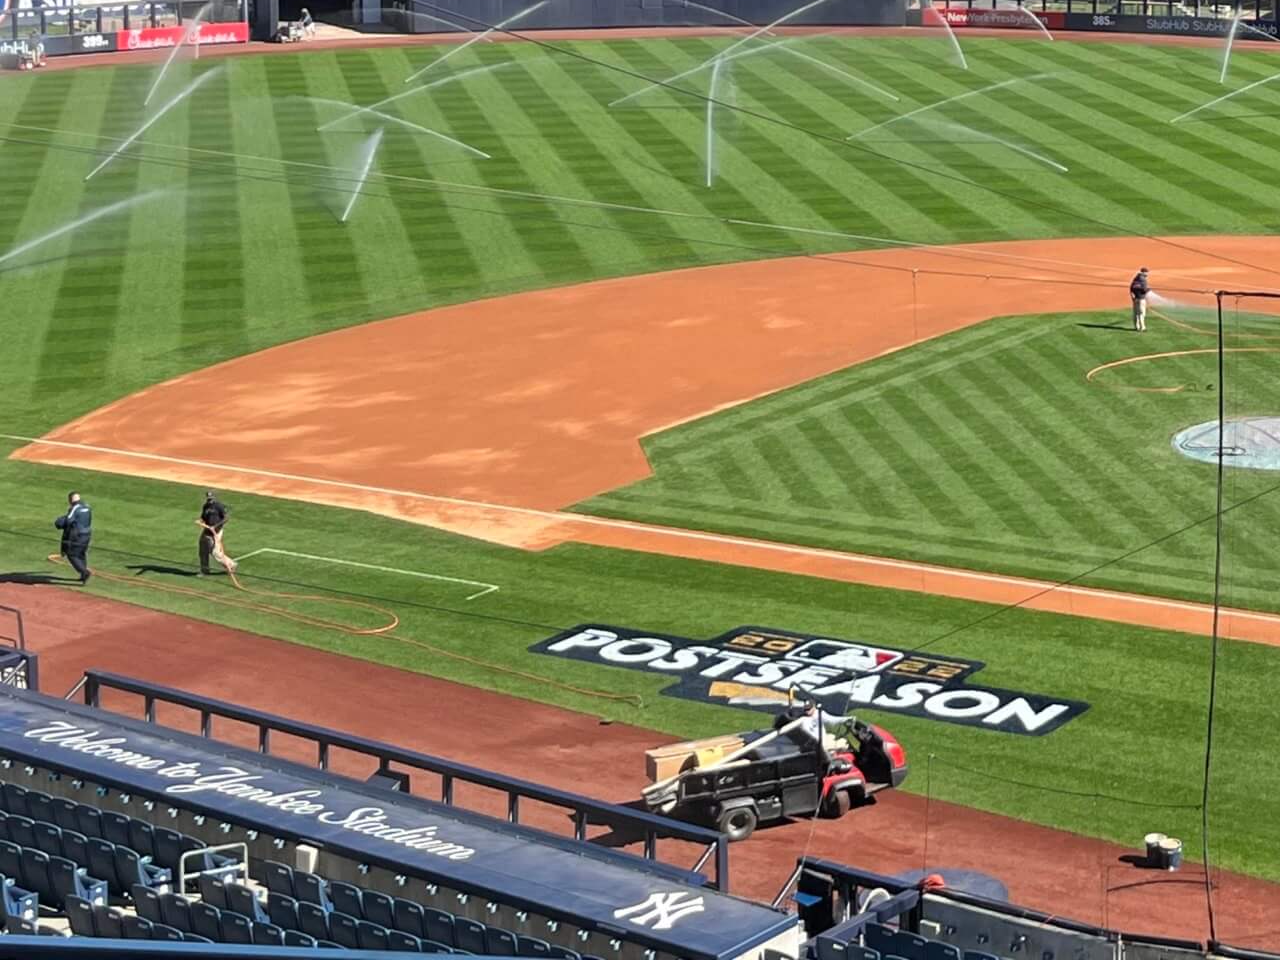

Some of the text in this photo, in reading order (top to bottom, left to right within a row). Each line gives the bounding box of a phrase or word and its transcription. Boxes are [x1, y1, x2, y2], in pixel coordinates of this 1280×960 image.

[1146, 19, 1189, 31] StubHub
[548, 628, 1069, 731] POSTSEASON
[24, 721, 475, 860] Welcome to Yankee Stadium
